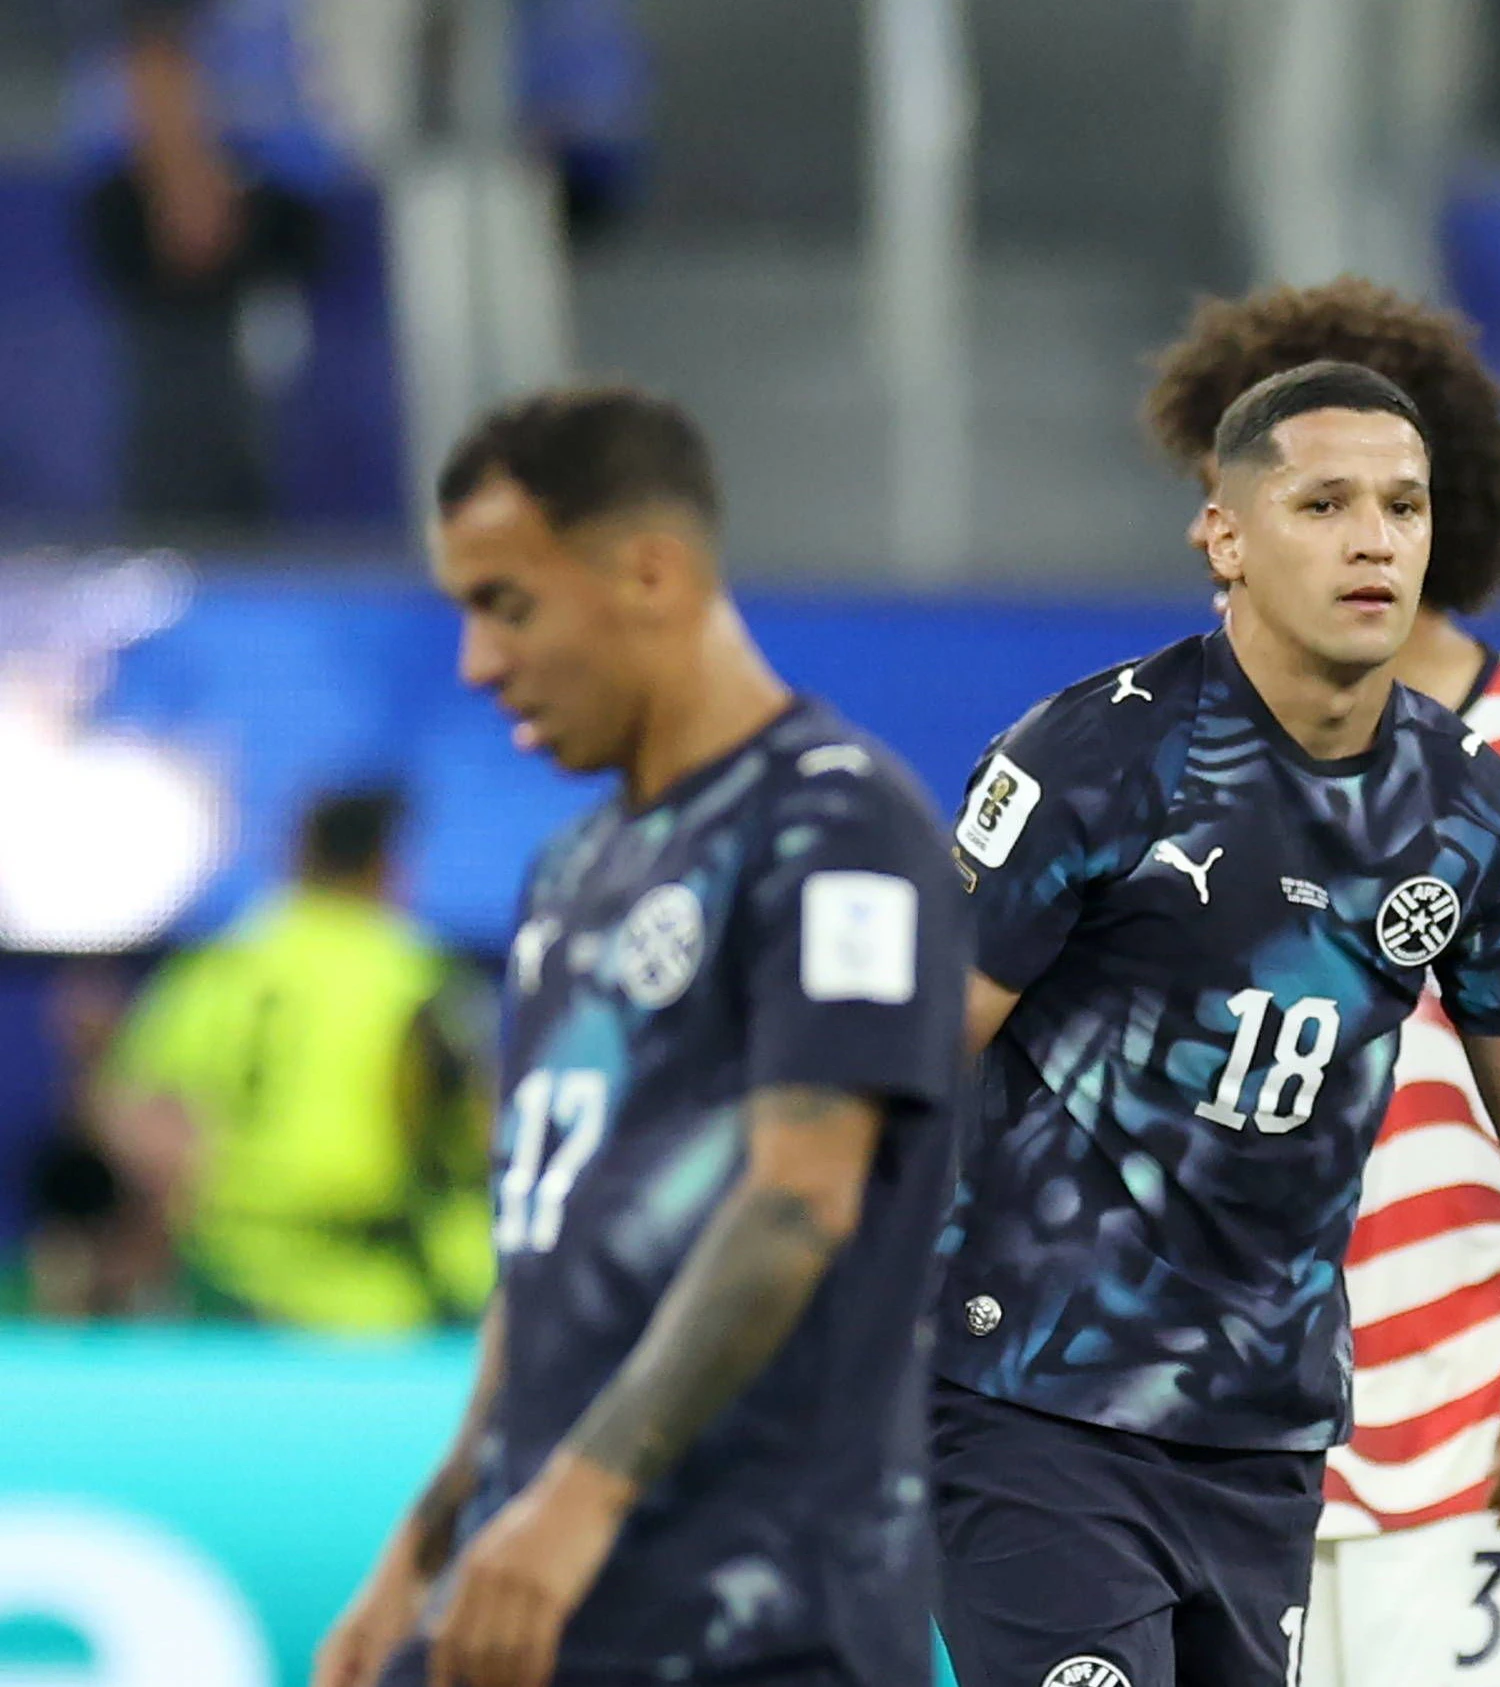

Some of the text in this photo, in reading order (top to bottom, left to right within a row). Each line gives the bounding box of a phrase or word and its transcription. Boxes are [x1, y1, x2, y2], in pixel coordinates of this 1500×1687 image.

[1412, 884, 1442, 902] APF
[1194, 987, 1340, 1135] 18
[493, 1069, 607, 1254] 17
[1063, 1662, 1093, 1685] APF
